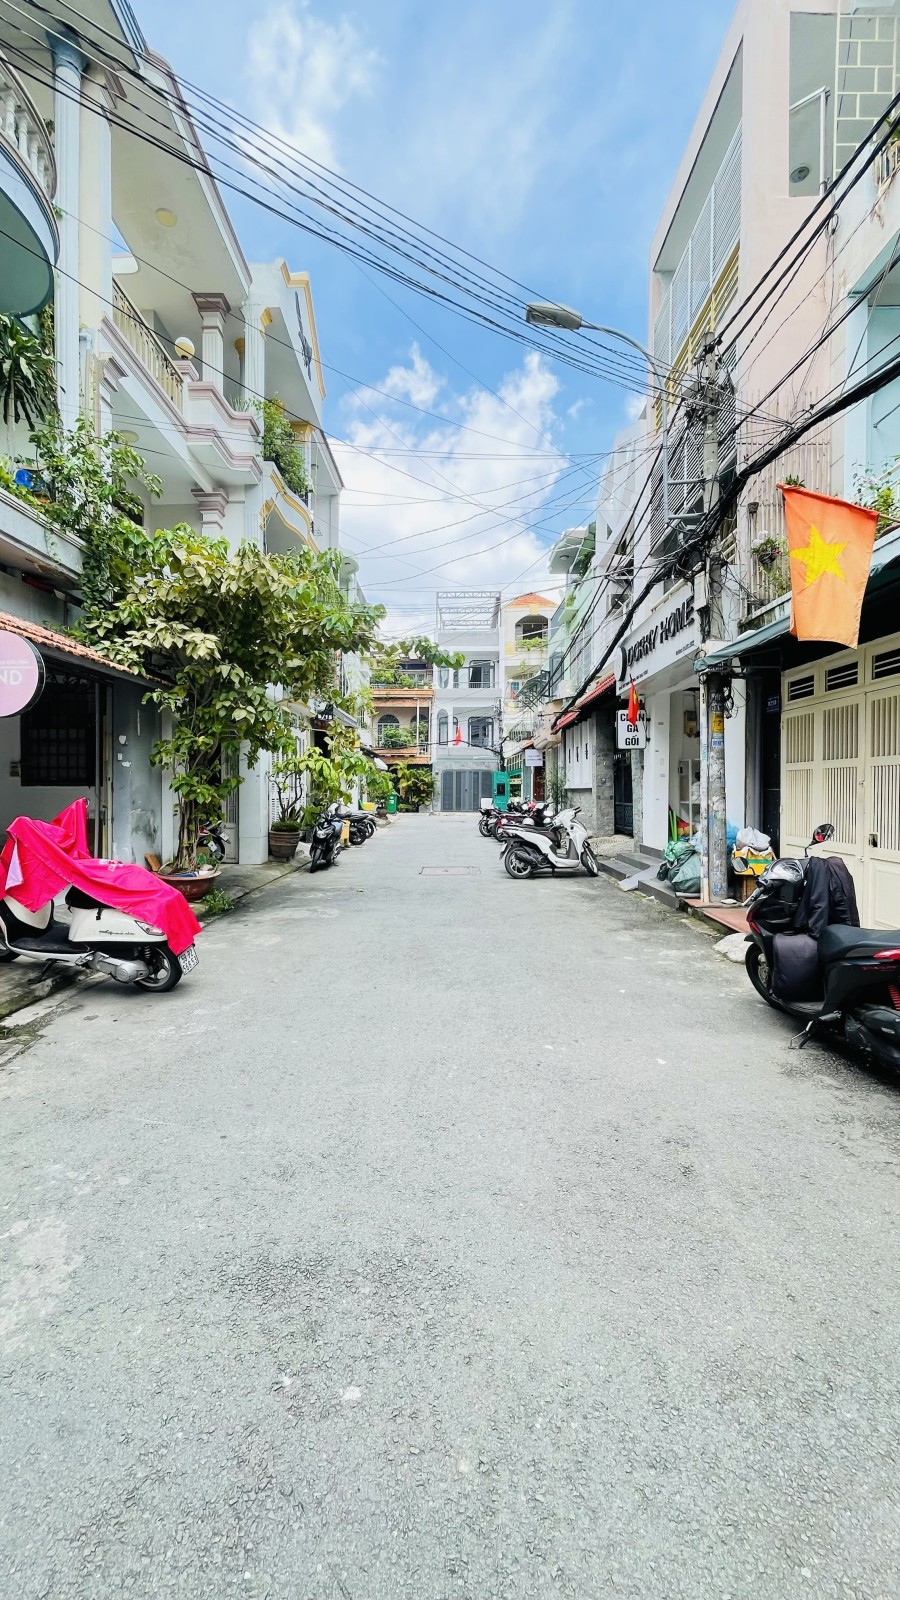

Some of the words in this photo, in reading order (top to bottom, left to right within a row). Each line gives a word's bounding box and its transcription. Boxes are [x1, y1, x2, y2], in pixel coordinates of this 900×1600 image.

[660, 596, 694, 644] HOME
[620, 713, 645, 721] CN
[625, 735, 639, 745] GỐI
